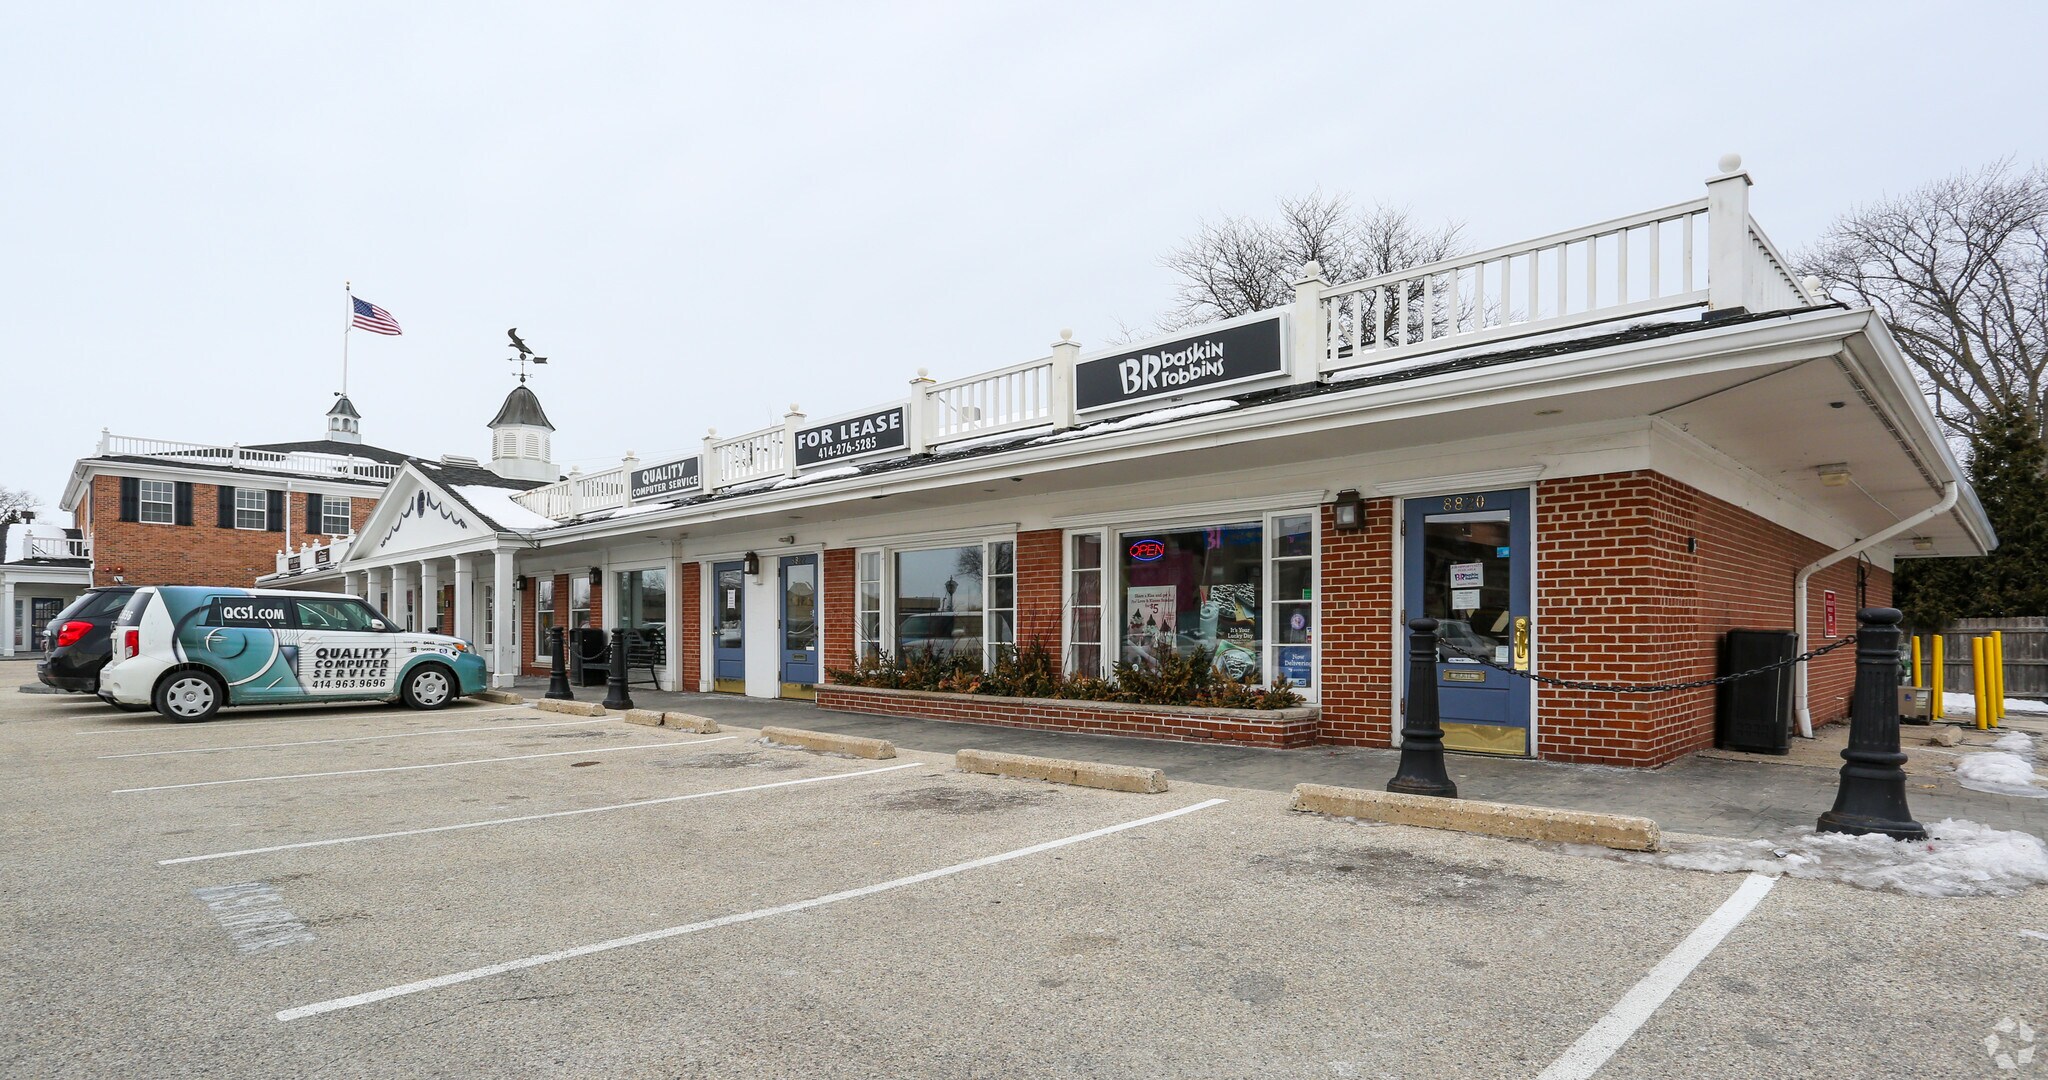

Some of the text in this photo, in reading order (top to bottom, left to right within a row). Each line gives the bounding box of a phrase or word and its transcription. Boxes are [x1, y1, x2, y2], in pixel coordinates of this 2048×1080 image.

[1119, 354, 1161, 394] BR
[798, 412, 900, 449] FOR LEASE
[818, 436, 877, 459] 414-276-5285
[642, 462, 685, 485] QUALITY
[632, 475, 698, 497] COMPUTER SERVICE
[1129, 543, 1165, 556] OPEN
[315, 647, 391, 660] QUALITY
[315, 659, 389, 668] COMPUTER
[313, 668, 388, 678] SERVICE
[312, 679, 386, 689] 414.963.9696
